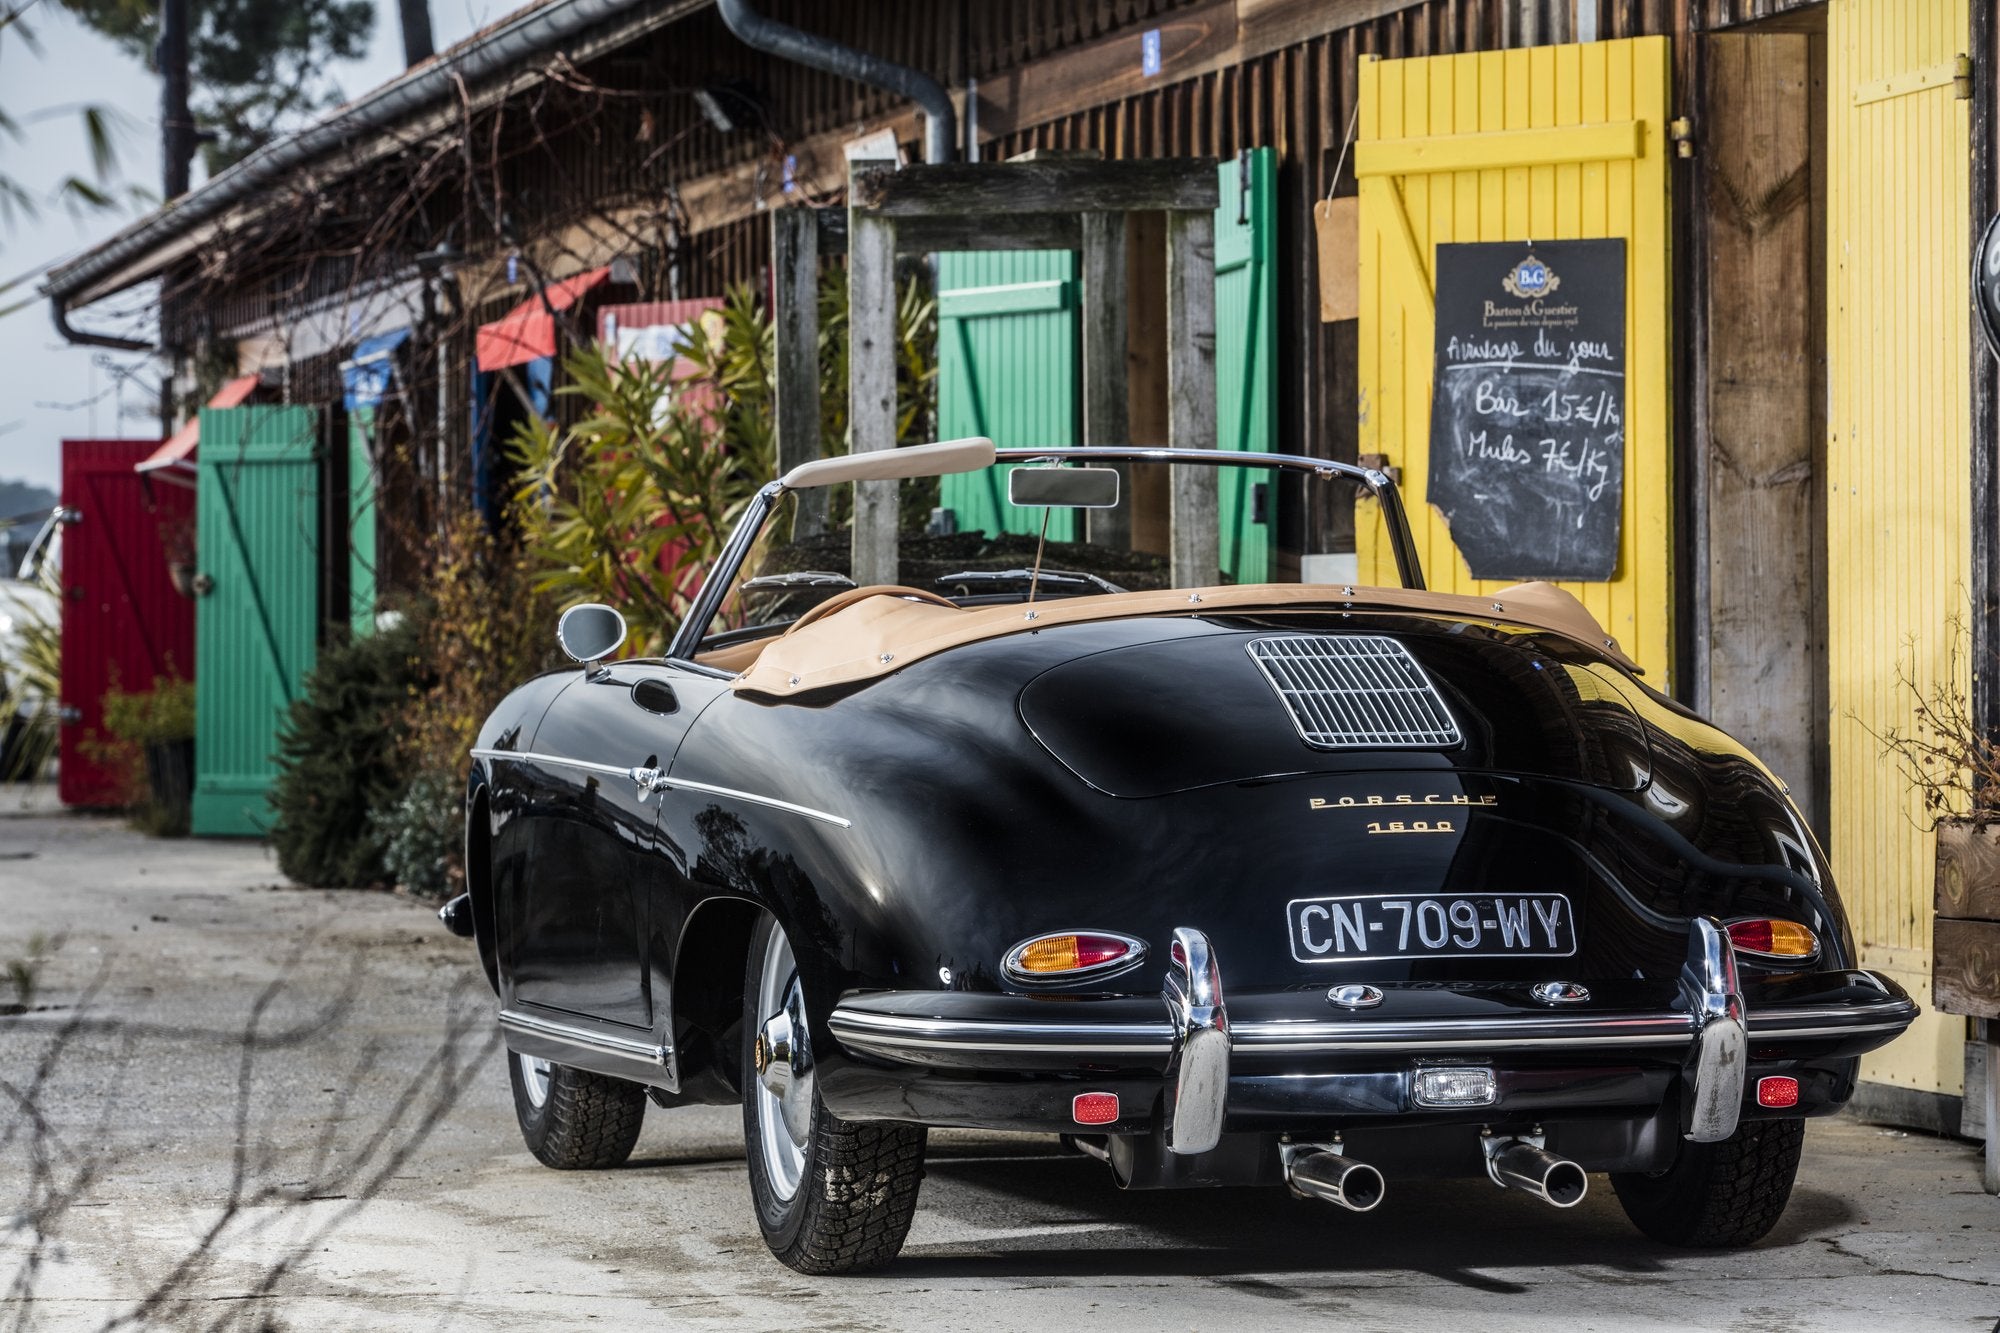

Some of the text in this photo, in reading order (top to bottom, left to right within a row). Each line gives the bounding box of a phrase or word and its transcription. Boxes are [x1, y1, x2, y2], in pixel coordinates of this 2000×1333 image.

[1484, 300, 1522, 317] Barton
[1534, 328, 1561, 357] du
[1566, 341, 1615, 375] jour
[1476, 380, 1531, 417] Bar
[1309, 794, 1498, 810] PORSCHE
[1367, 821, 1455, 834] 1600
[1301, 899, 1561, 953] CN-709-WY
